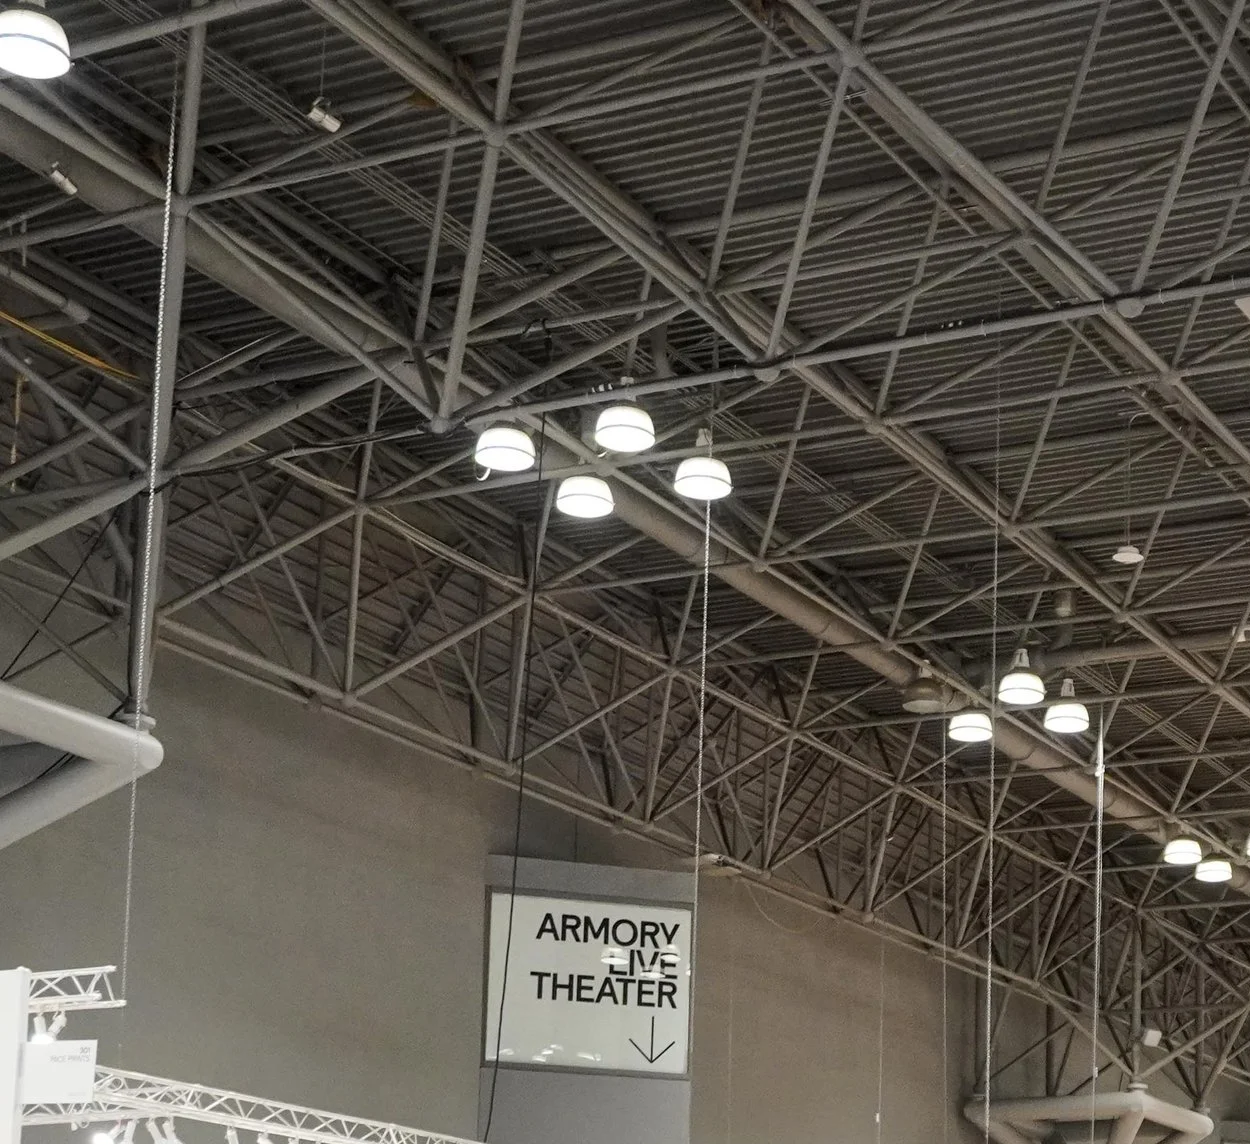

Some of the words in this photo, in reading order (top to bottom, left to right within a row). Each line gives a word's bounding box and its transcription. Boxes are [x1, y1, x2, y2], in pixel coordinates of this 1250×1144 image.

[535, 912, 680, 949] ARMORY
[609, 949, 678, 980] LIVE
[530, 971, 678, 1009] THEATER
